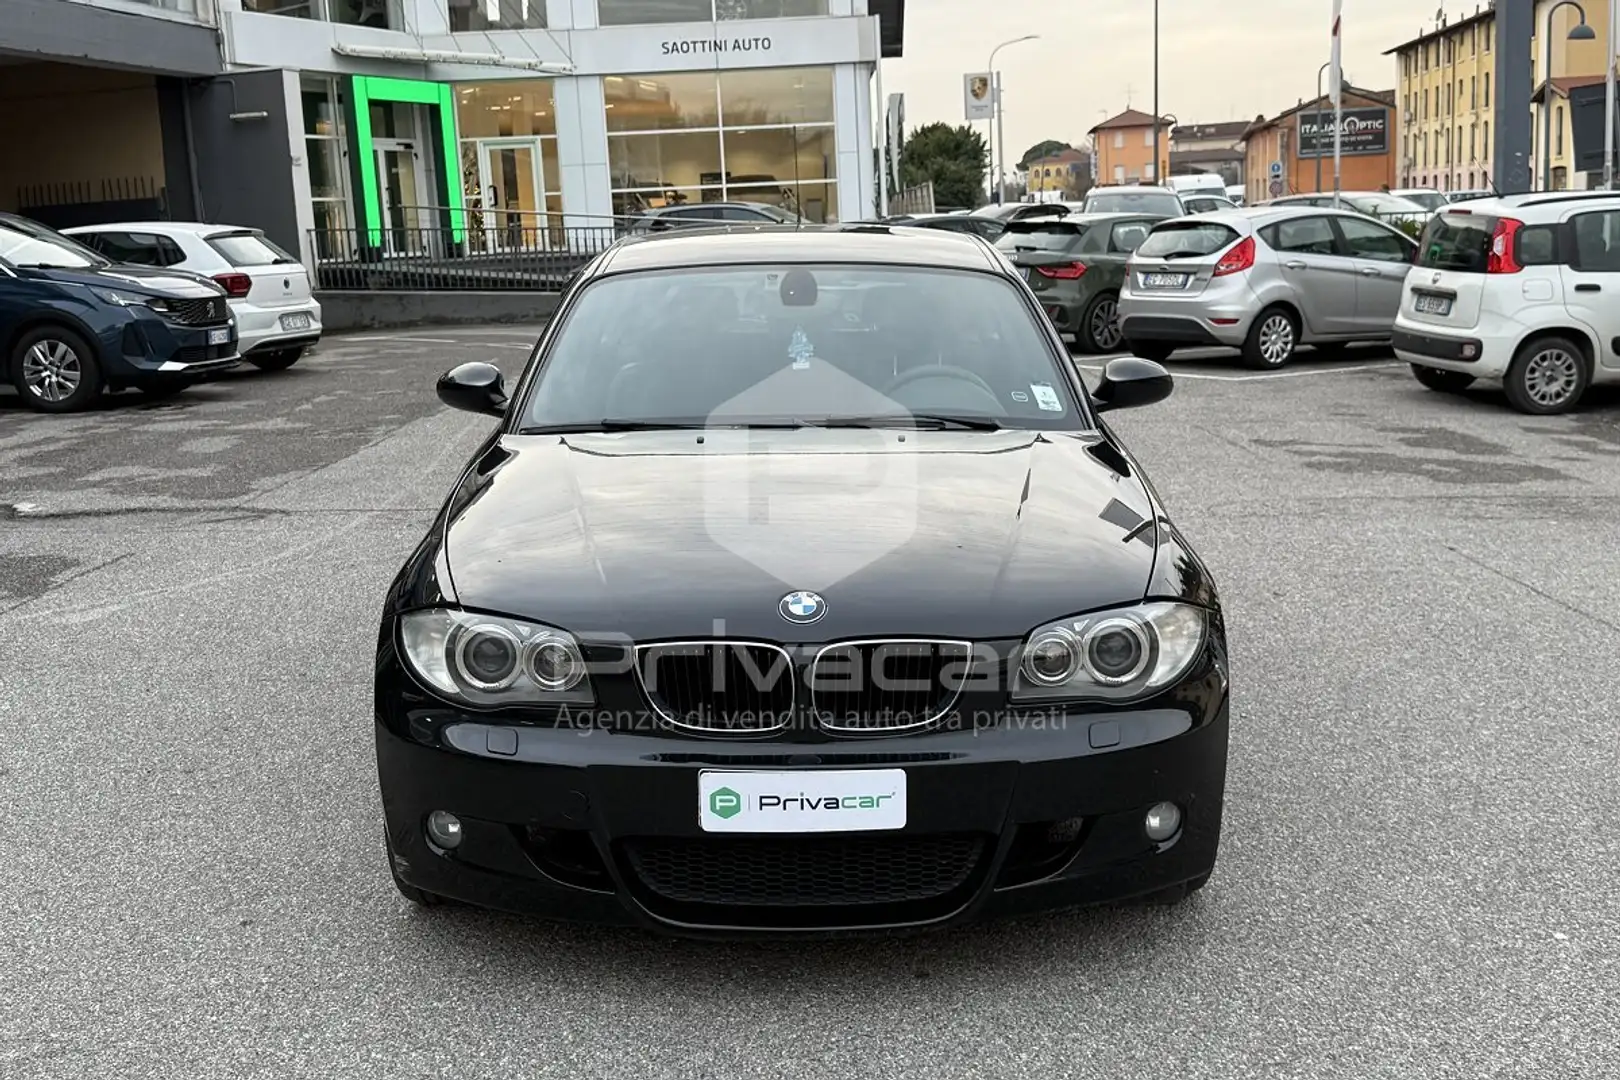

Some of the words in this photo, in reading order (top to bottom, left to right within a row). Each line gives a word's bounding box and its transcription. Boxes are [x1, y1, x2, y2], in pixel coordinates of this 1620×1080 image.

[661, 39, 728, 55] SAOTTINI
[732, 37, 772, 52] AUTO
[715, 795, 737, 810] P
[758, 791, 895, 811] Privacar
